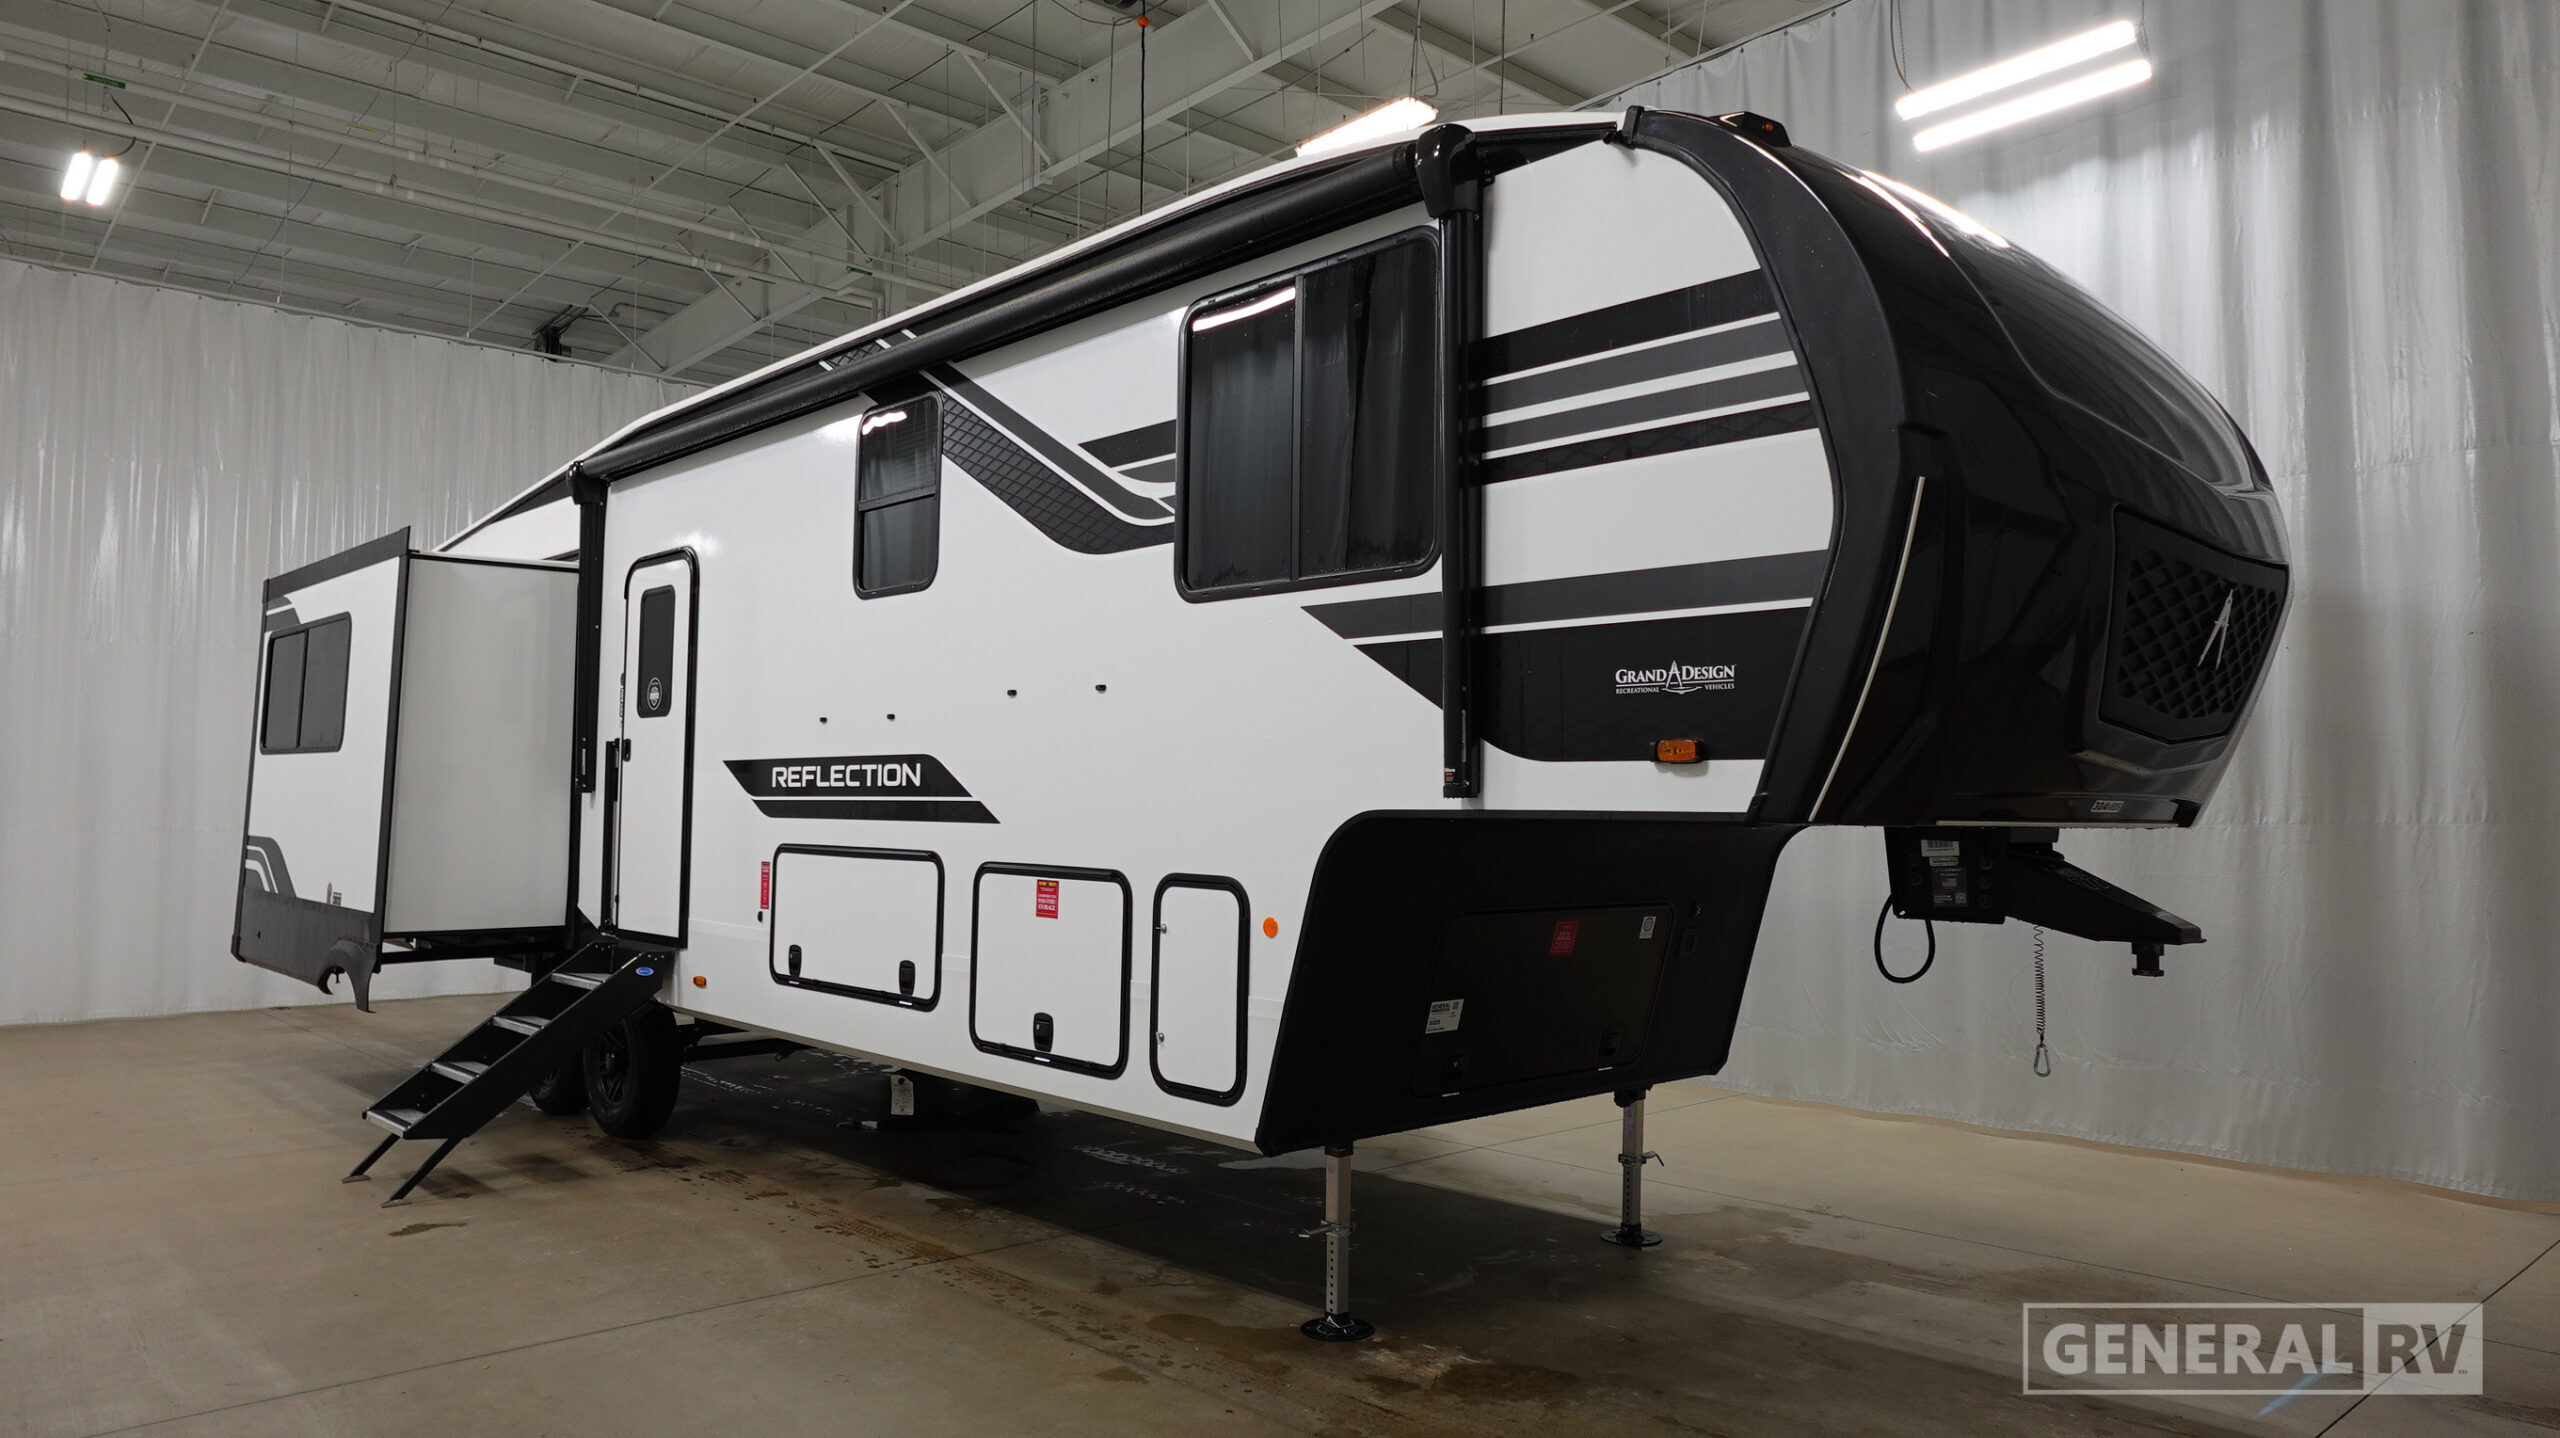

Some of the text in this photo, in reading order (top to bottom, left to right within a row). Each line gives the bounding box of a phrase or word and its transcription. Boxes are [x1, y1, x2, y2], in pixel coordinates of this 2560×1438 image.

[1615, 665, 1736, 683] GRAND DESIGN
[1615, 686, 1660, 694] RECREATIONAL
[771, 763, 922, 788] REFLECTION
